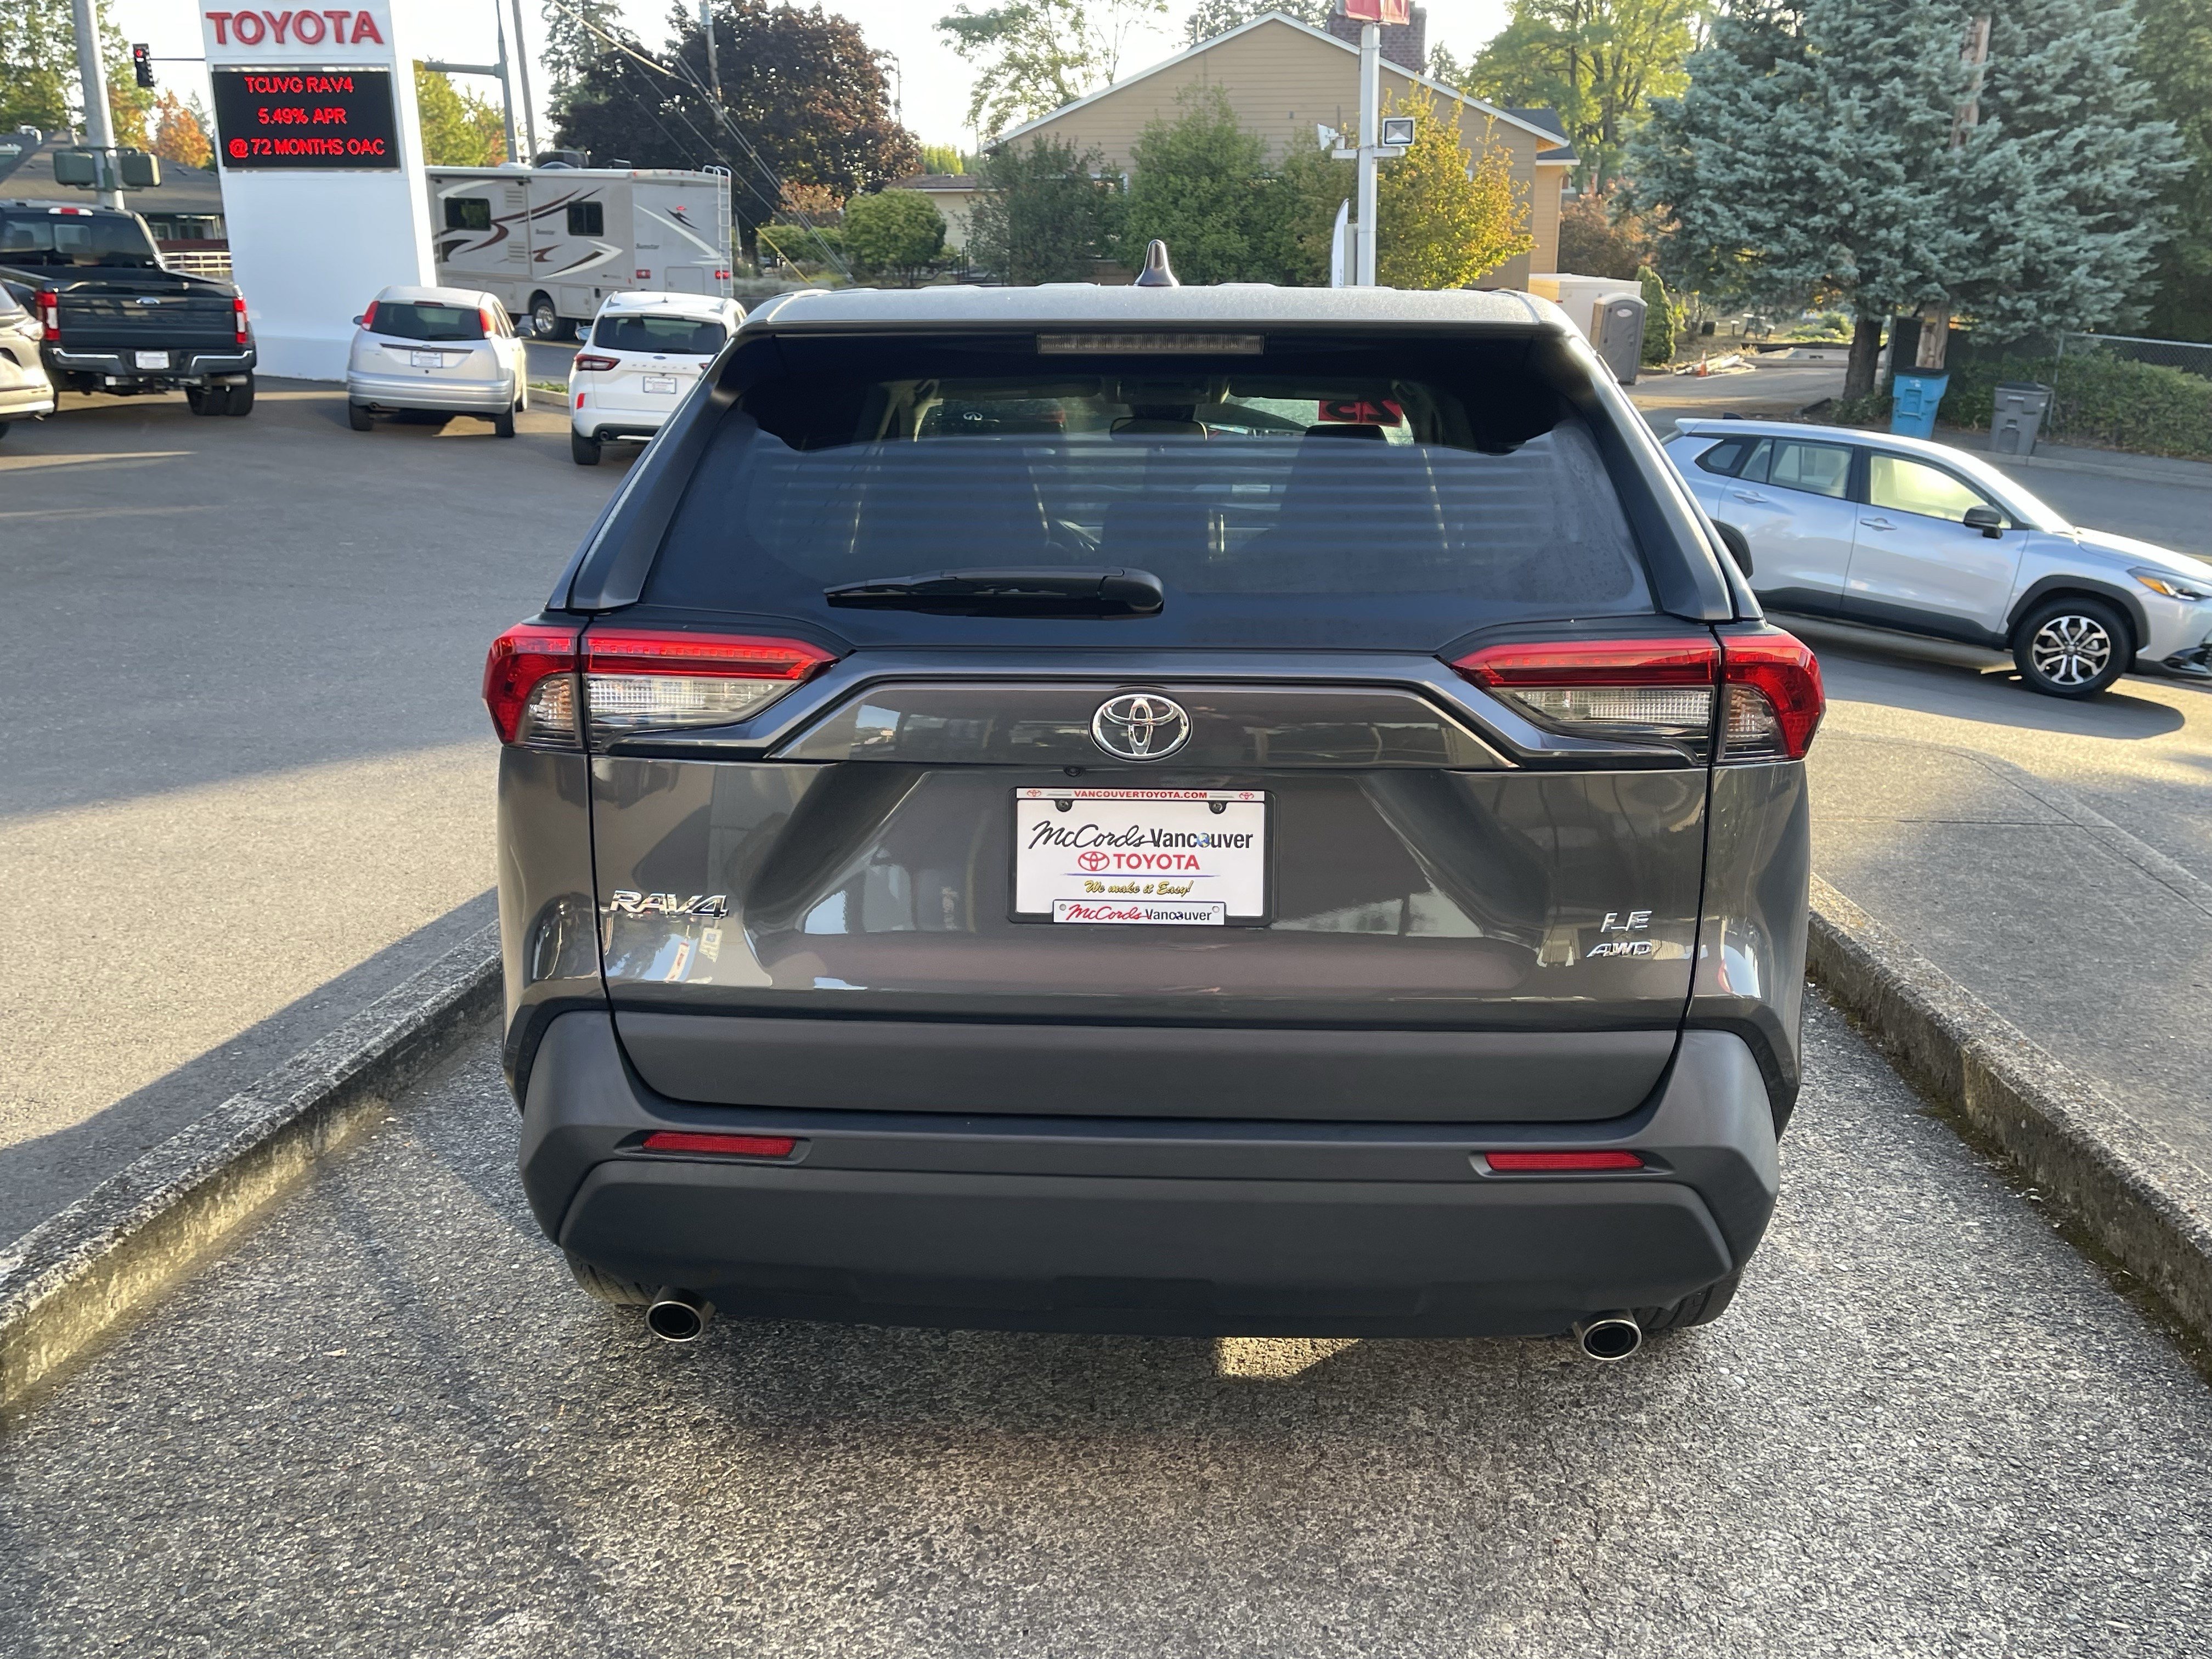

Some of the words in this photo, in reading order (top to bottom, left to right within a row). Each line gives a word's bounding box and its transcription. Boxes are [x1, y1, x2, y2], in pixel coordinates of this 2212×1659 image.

[205, 10, 385, 45] TOYOTA
[306, 75, 354, 93] RAV4
[258, 107, 309, 125] 5.49%
[312, 108, 348, 125] APR
[228, 138, 249, 159] @
[250, 138, 272, 155] 72
[273, 138, 345, 155] MONTHS
[346, 138, 385, 155] OAC
[1074, 790, 1207, 799] VANCOUVERTOYOTA.COM
[1113, 853, 1200, 870] TOYOTA
[1084, 879, 1105, 893] We
[1108, 881, 1140, 894] make
[1143, 882, 1154, 894] it
[1156, 879, 1194, 898] Easy!
[610, 889, 730, 920] RAV4
[1600, 910, 1652, 933] LE
[1585, 940, 1653, 958] AWD
